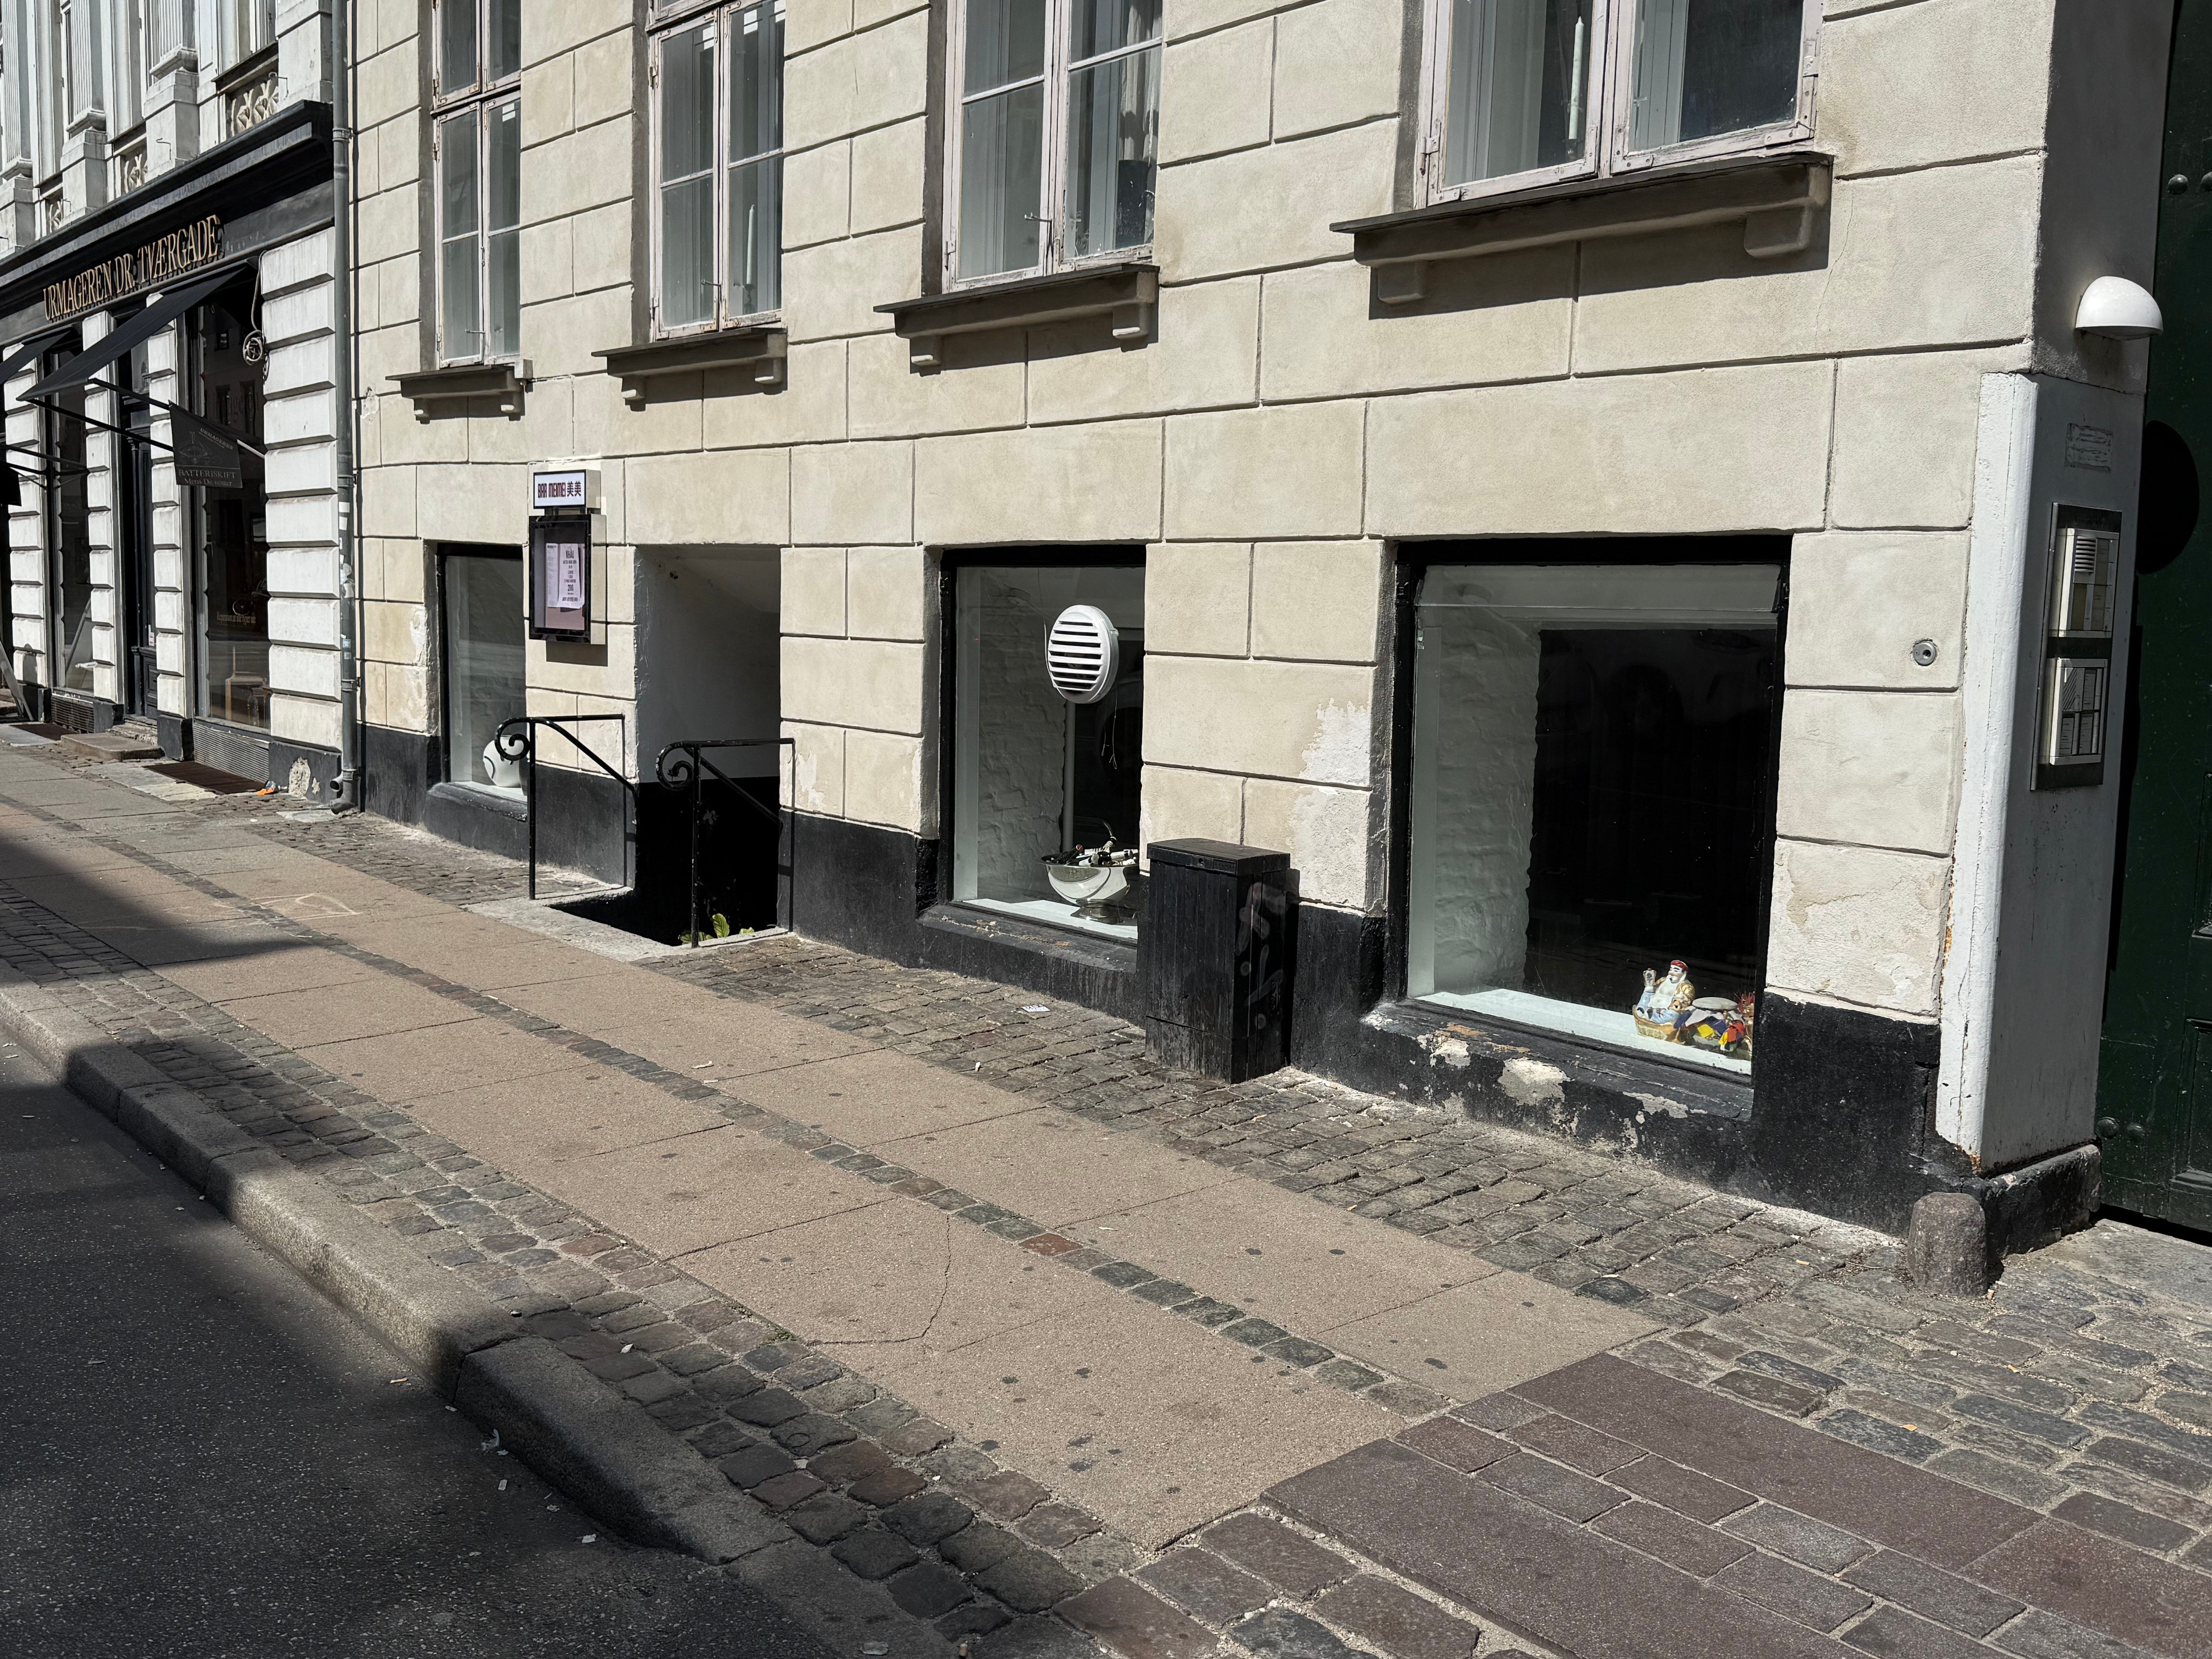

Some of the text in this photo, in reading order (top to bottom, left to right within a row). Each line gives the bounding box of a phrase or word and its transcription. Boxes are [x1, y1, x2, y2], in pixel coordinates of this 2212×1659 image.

[43, 214, 218, 320] URMAGEREN DR. TVÆRGADE
[200, 428, 234, 450] URMAGEREN
[179, 469, 236, 479] BATTERISKIFT
[538, 483, 547, 498] BAR
[567, 481, 581, 496] 美美
